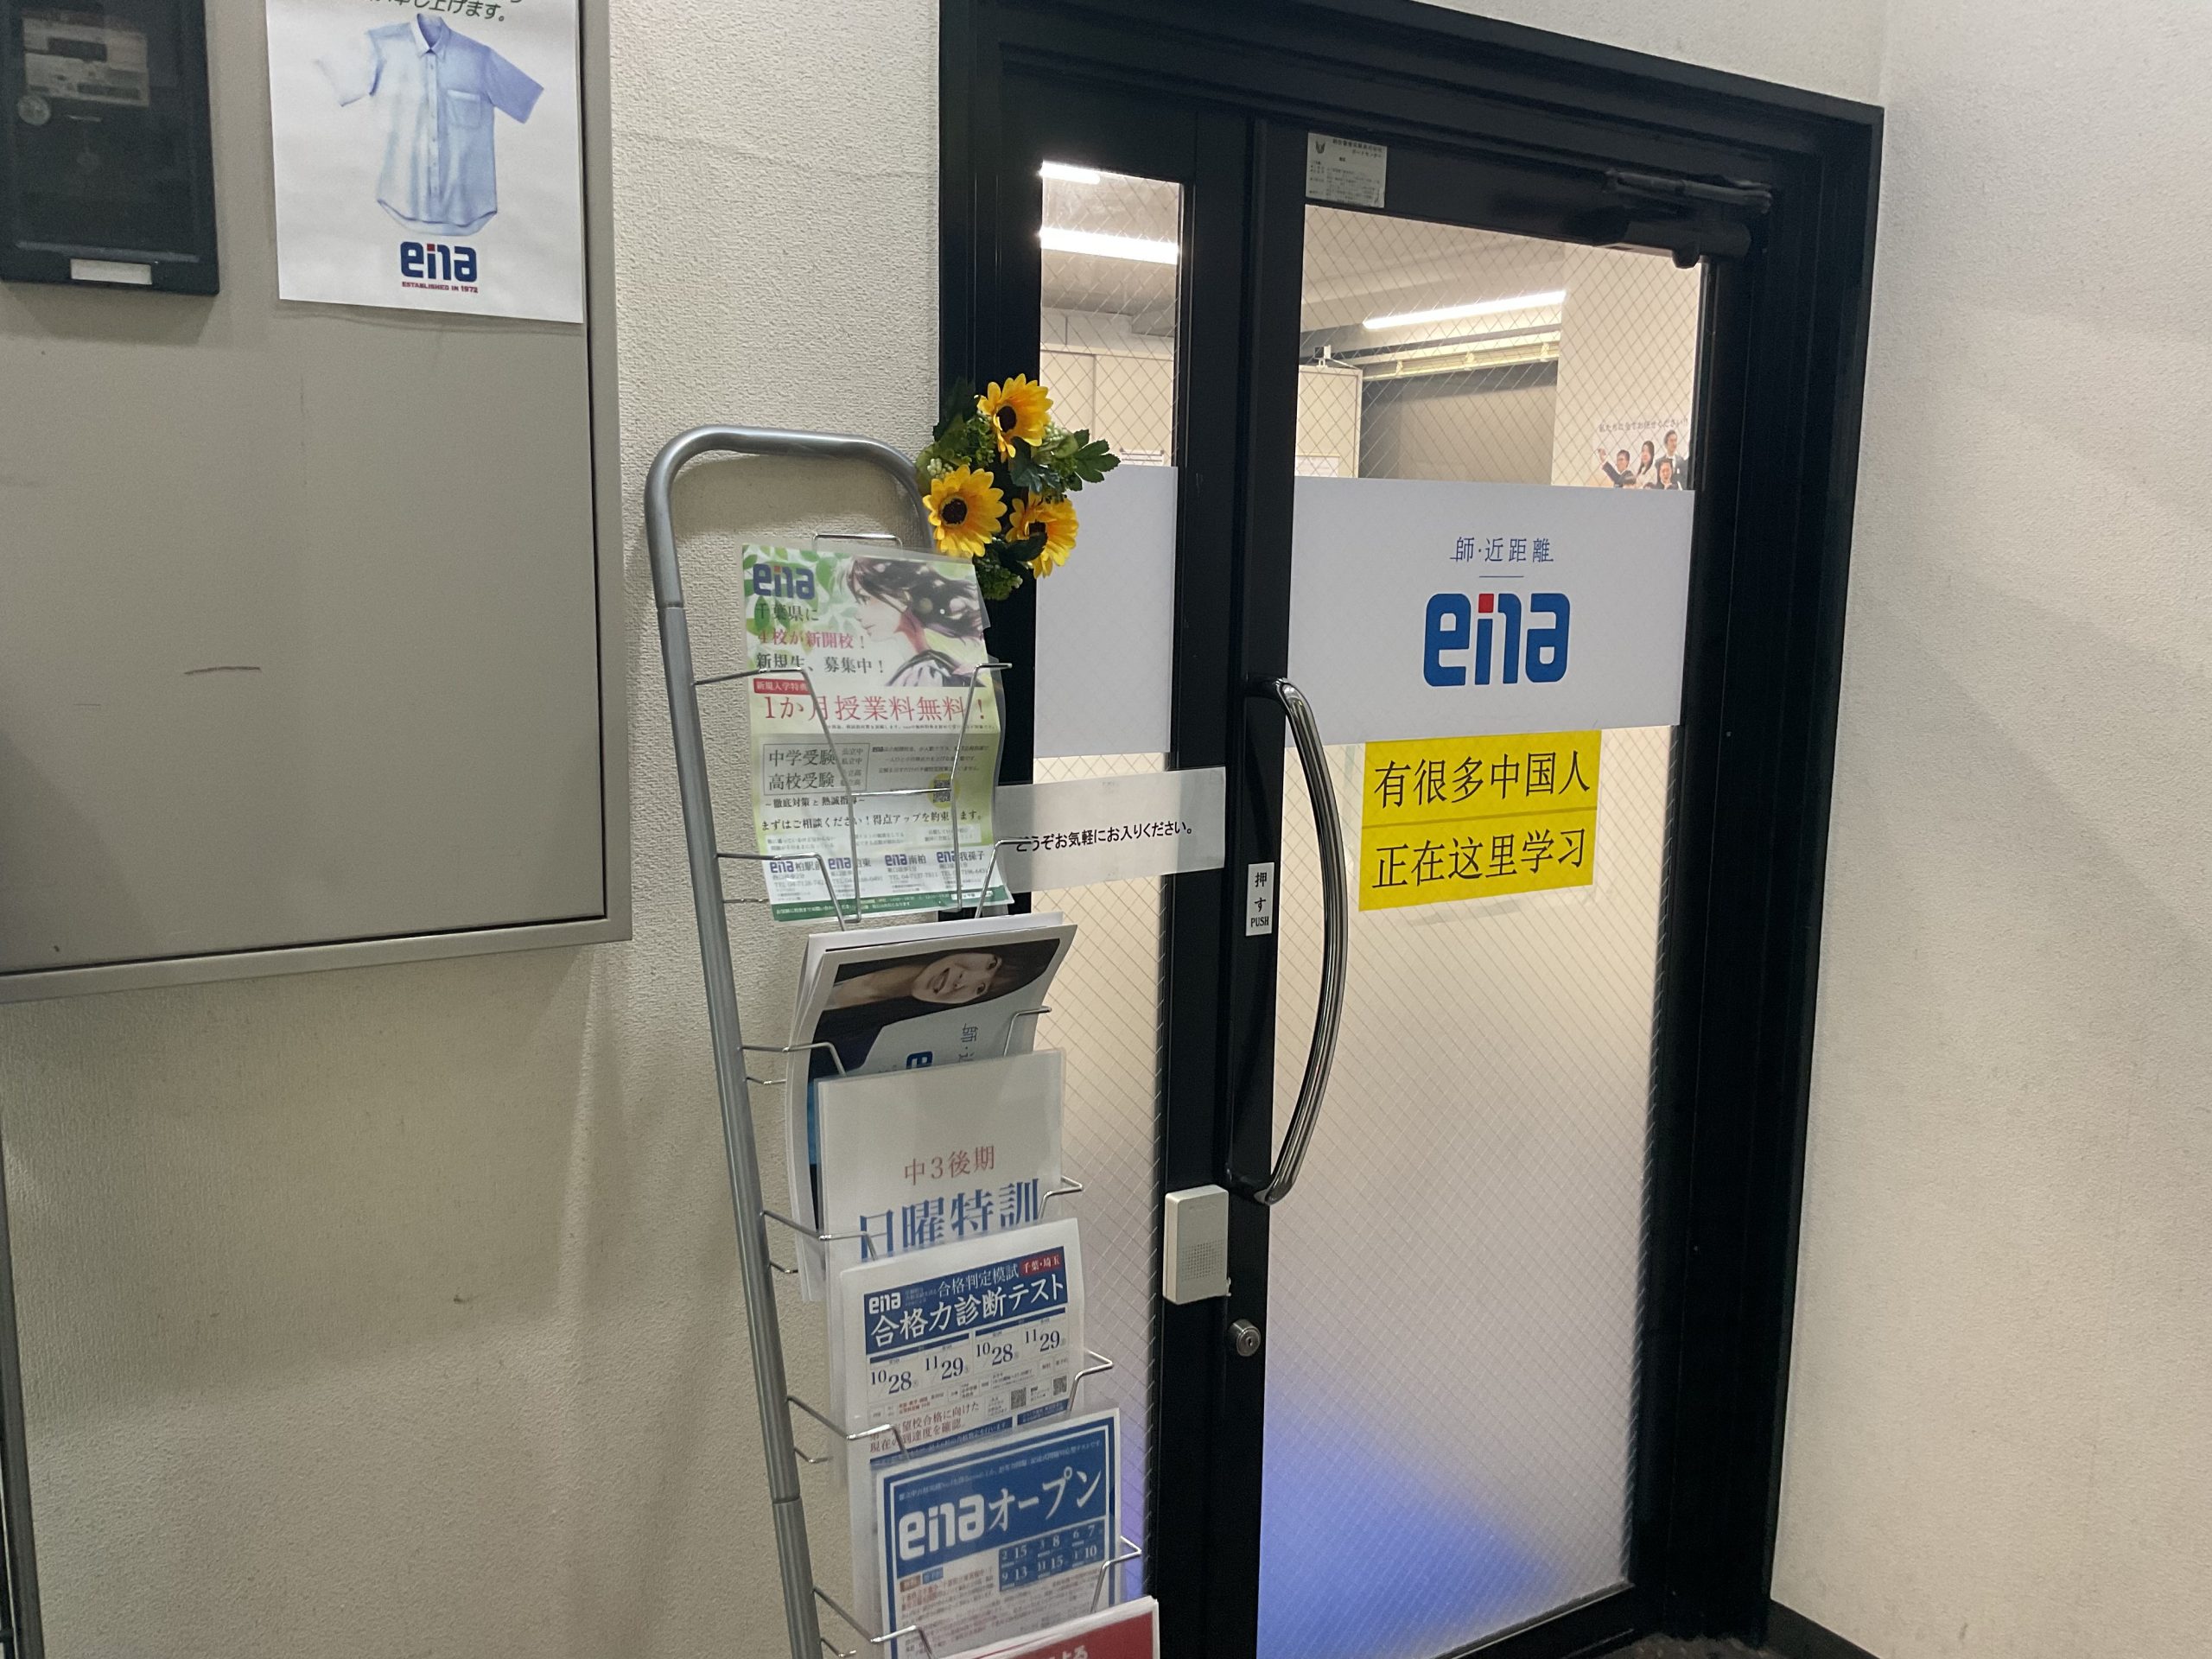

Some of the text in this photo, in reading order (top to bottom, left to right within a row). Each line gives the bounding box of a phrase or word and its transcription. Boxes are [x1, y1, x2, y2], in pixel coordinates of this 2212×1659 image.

[400, 241, 478, 283] ena
[402, 281, 449, 290] ESTABLISHED
[461, 285, 479, 294] 1972
[753, 563, 815, 600] ena
[756, 603, 820, 622] 千葉県に
[1423, 593, 1571, 687] ena
[769, 749, 836, 767] 中学受験
[768, 772, 835, 791] 高校受験
[1374, 750, 1591, 809] 有很多中国人
[1015, 820, 1193, 853] どうぞお気軽にお入りください。
[769, 861, 794, 874] ena
[828, 856, 852, 870] ena
[884, 854, 907, 867] ena
[1371, 828, 1586, 889] 正在这里学习
[1254, 871, 1268, 912] 押す
[1250, 915, 1269, 928] PUSH
[904, 1145, 995, 1186] 中3後期
[860, 1178, 1039, 1262] 日曜特訓
[938, 1262, 1020, 1299] 合格判定模試
[868, 1292, 901, 1315] ena
[870, 1274, 1064, 1348] 合格力診断テスト
[1025, 1329, 1060, 1352] 11 29
[976, 1342, 1014, 1366] 10 28
[925, 1355, 964, 1380] 11 29
[871, 1370, 912, 1395] 10 28
